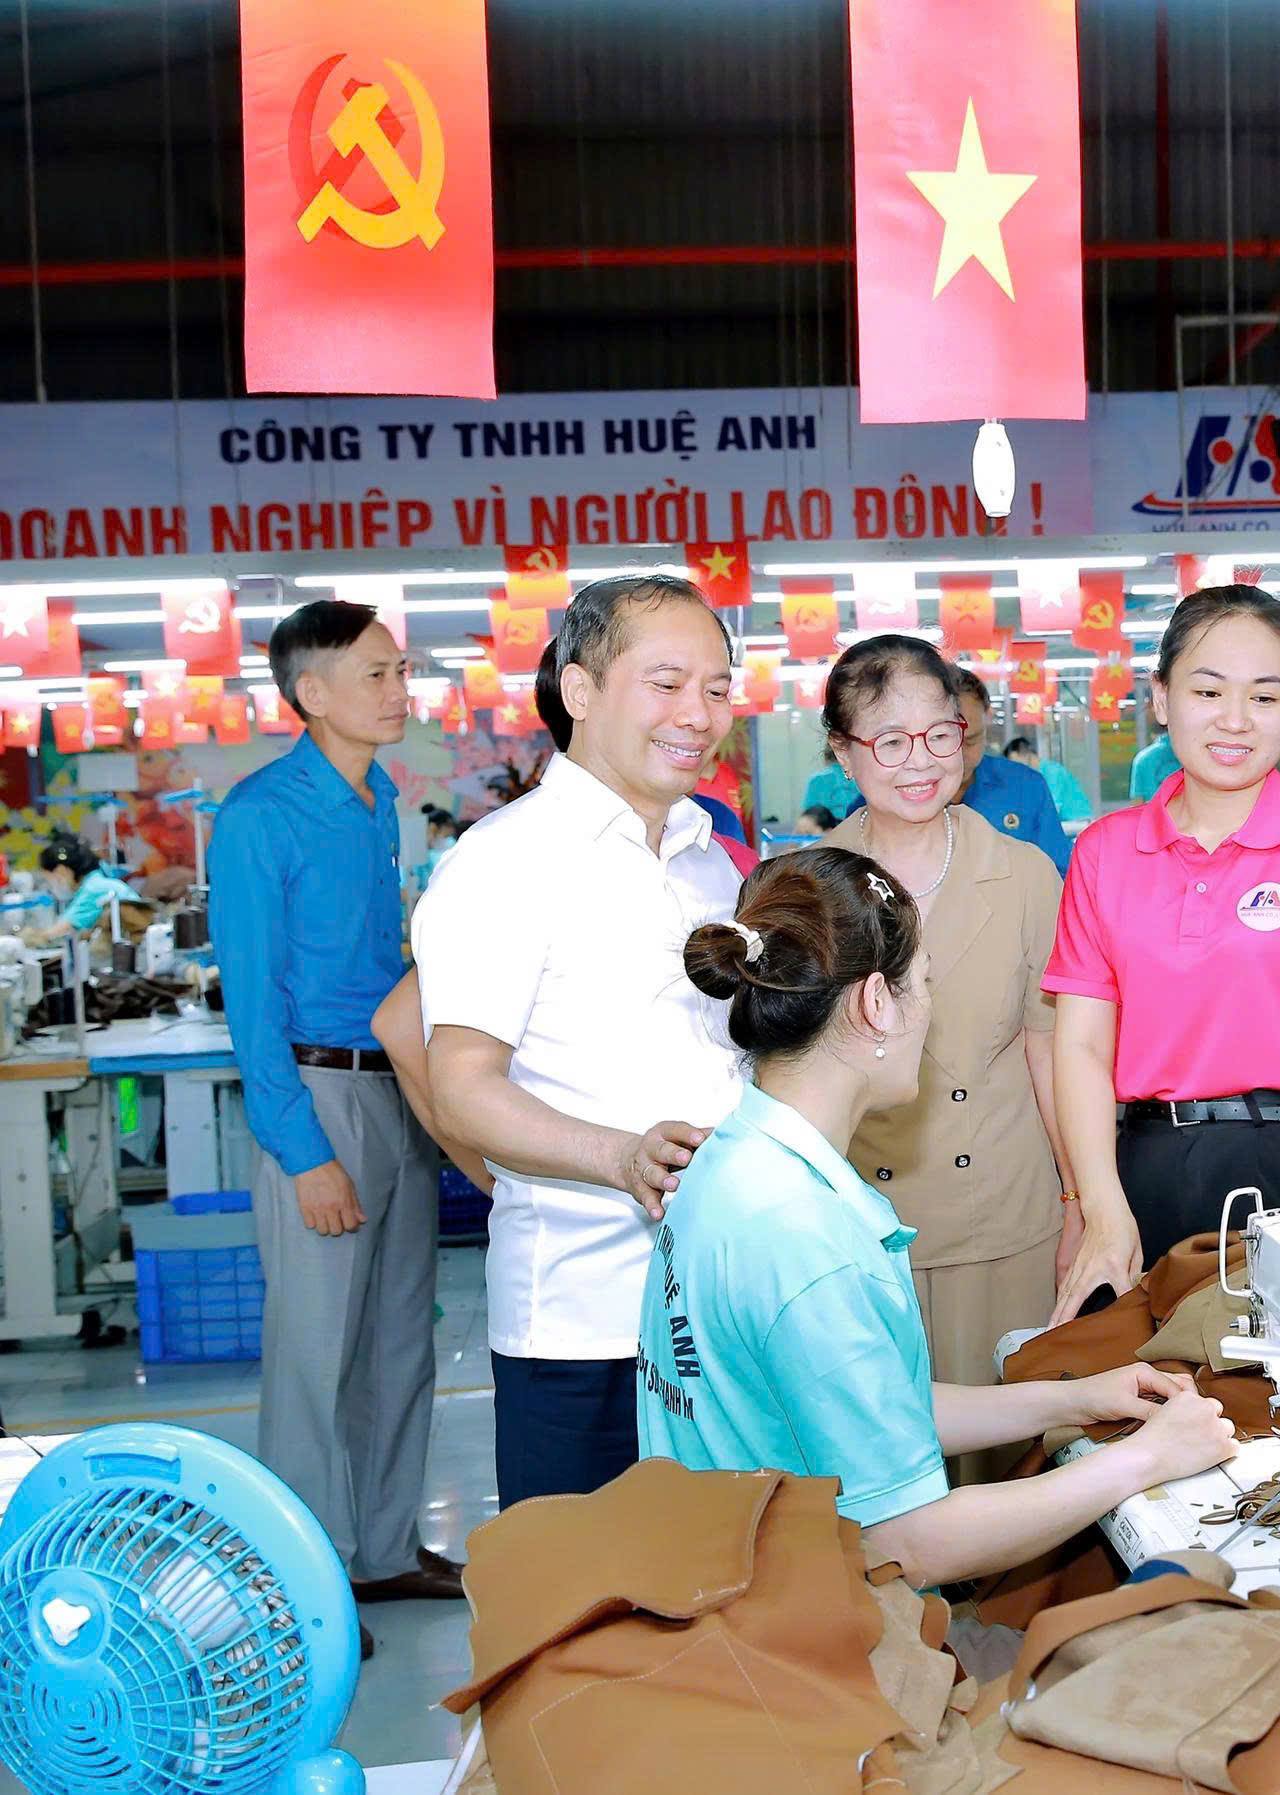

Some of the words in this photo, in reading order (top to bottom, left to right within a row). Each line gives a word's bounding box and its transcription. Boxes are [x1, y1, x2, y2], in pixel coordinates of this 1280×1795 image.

[219, 419, 361, 463] CÔNG
[379, 423, 434, 459] TY
[454, 421, 585, 457] TNHH
[604, 410, 698, 460] HUỆ
[717, 415, 817, 451] ANH
[453, 484, 506, 545] VÌ
[530, 478, 709, 545] NGƯỜI
[731, 488, 833, 542] LAO
[669, 1315, 700, 1377] ANH
